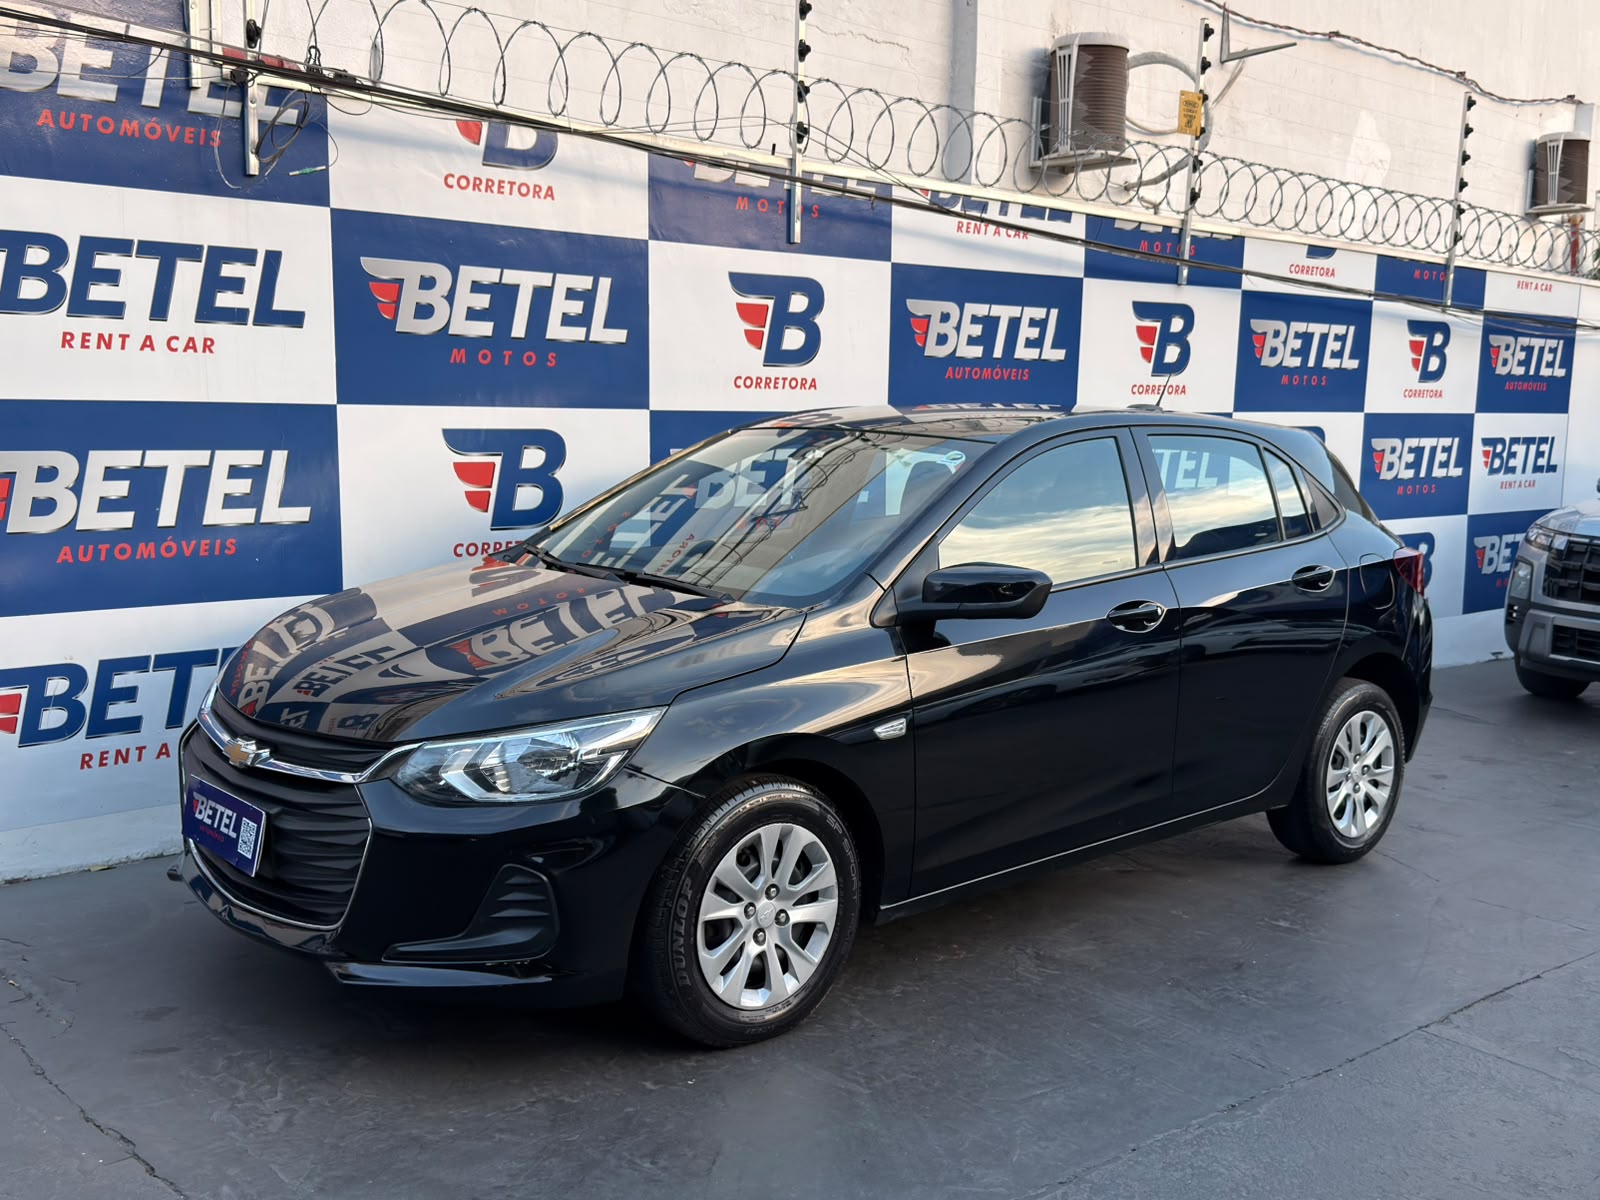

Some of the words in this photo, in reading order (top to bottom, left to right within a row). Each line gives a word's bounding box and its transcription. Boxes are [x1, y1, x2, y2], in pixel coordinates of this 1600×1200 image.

[37, 108, 222, 147] AUTOMÓVEIS
[443, 173, 555, 201] CORRETORA
[736, 196, 819, 218] MOTS
[956, 220, 990, 236] RENT
[993, 226, 1001, 237] A
[0, 229, 306, 329] BETEL
[1289, 264, 1336, 278] CORRETORA
[1413, 269, 1447, 282] MOTO
[1516, 279, 1533, 291] RENT
[1540, 282, 1553, 292] CAR
[360, 256, 629, 345] BETEL
[728, 271, 825, 367] B
[906, 299, 1067, 362] BETEL
[60, 331, 131, 350] RENT
[139, 334, 156, 353] A
[165, 335, 216, 354] CAR
[1132, 300, 1195, 377] B
[1250, 319, 1360, 370] BETEL
[1407, 319, 1450, 384] B
[449, 348, 557, 368] MOTOS
[1488, 334, 1567, 378] BETEL
[733, 375, 818, 391] CORRETORA
[944, 364, 1030, 381] AUTOMÓVEIS
[1280, 374, 1328, 387] MOTOS
[1504, 380, 1547, 392] AUTOMÓVEIS
[1130, 384, 1187, 396] CORRETORA
[1403, 388, 1443, 399] CORRETORA
[1371, 437, 1464, 481] BETEL
[1481, 436, 1558, 476] BETEL
[0, 449, 312, 534] BETEL
[441, 428, 567, 531] B
[1397, 483, 1436, 496] MOTOS
[1500, 480, 1517, 490] RENT
[1523, 480, 1536, 489] CAR
[56, 536, 238, 564] AUTOMÓVEIS
[0, 647, 240, 748] BET
[80, 745, 147, 770] RENT
[155, 742, 171, 760] A
[193, 791, 237, 839] BETEL
[671, 877, 694, 988] DUNLOP
